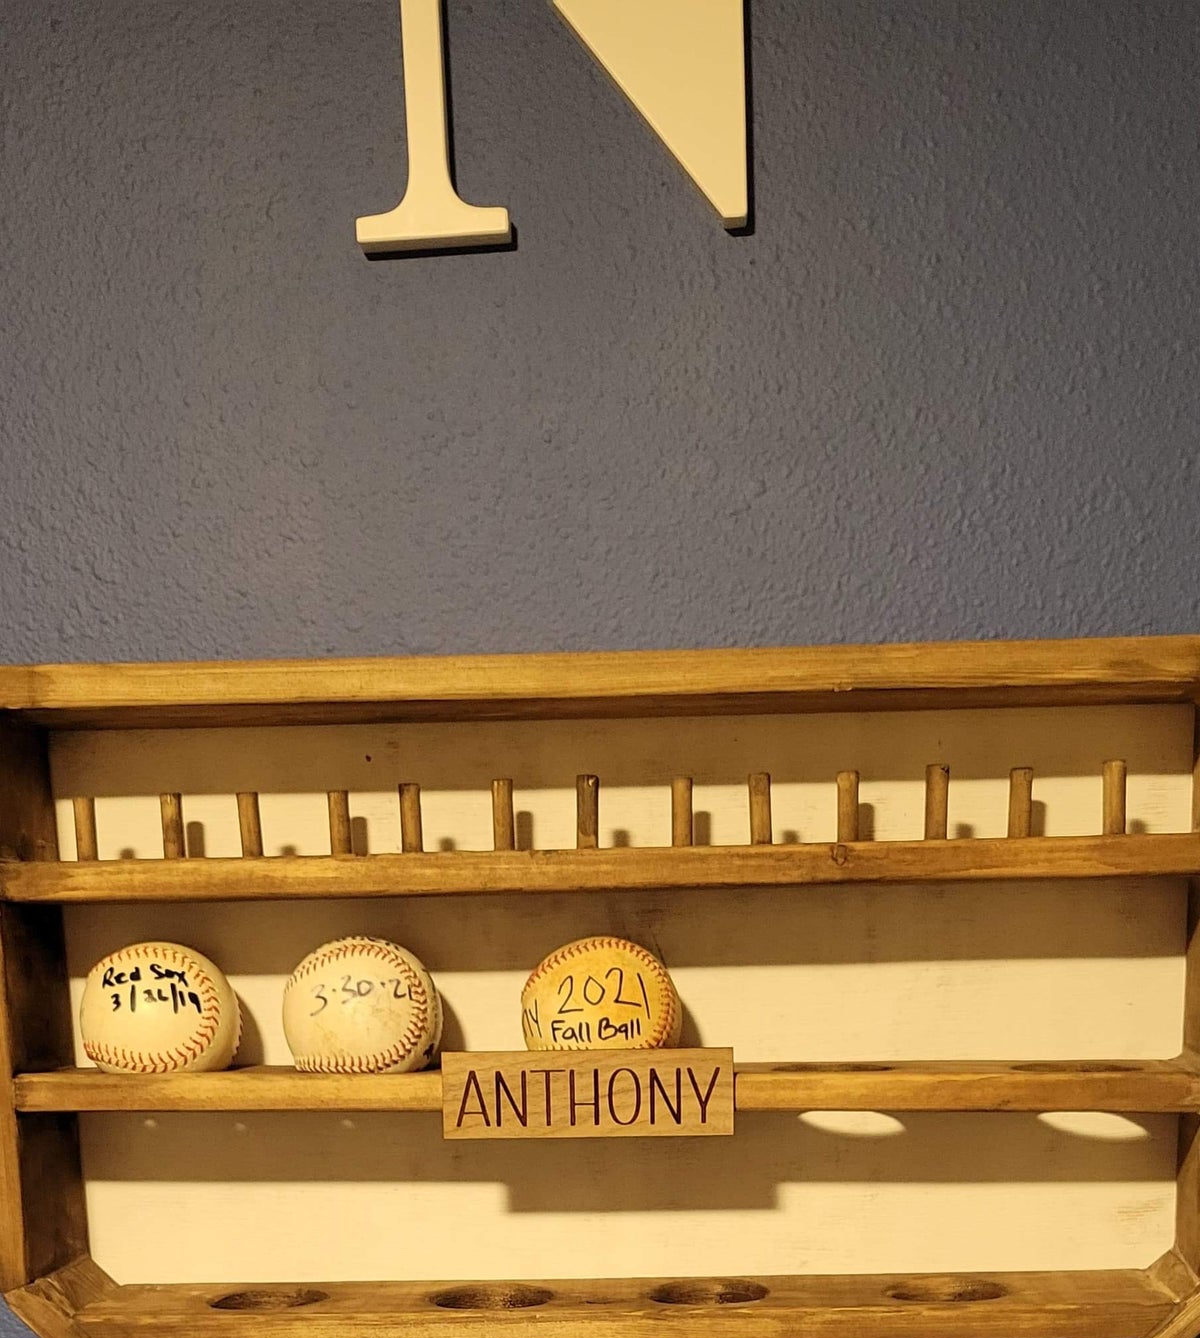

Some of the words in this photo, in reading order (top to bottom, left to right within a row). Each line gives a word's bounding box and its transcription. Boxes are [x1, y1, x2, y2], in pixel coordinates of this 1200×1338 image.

[102, 966, 142, 988] Red
[149, 963, 189, 988] Sox
[557, 967, 651, 1021] 2021
[551, 1019, 592, 1043] Fall
[598, 1017, 641, 1041] Ball
[456, 1066, 721, 1128] ANTHONY
